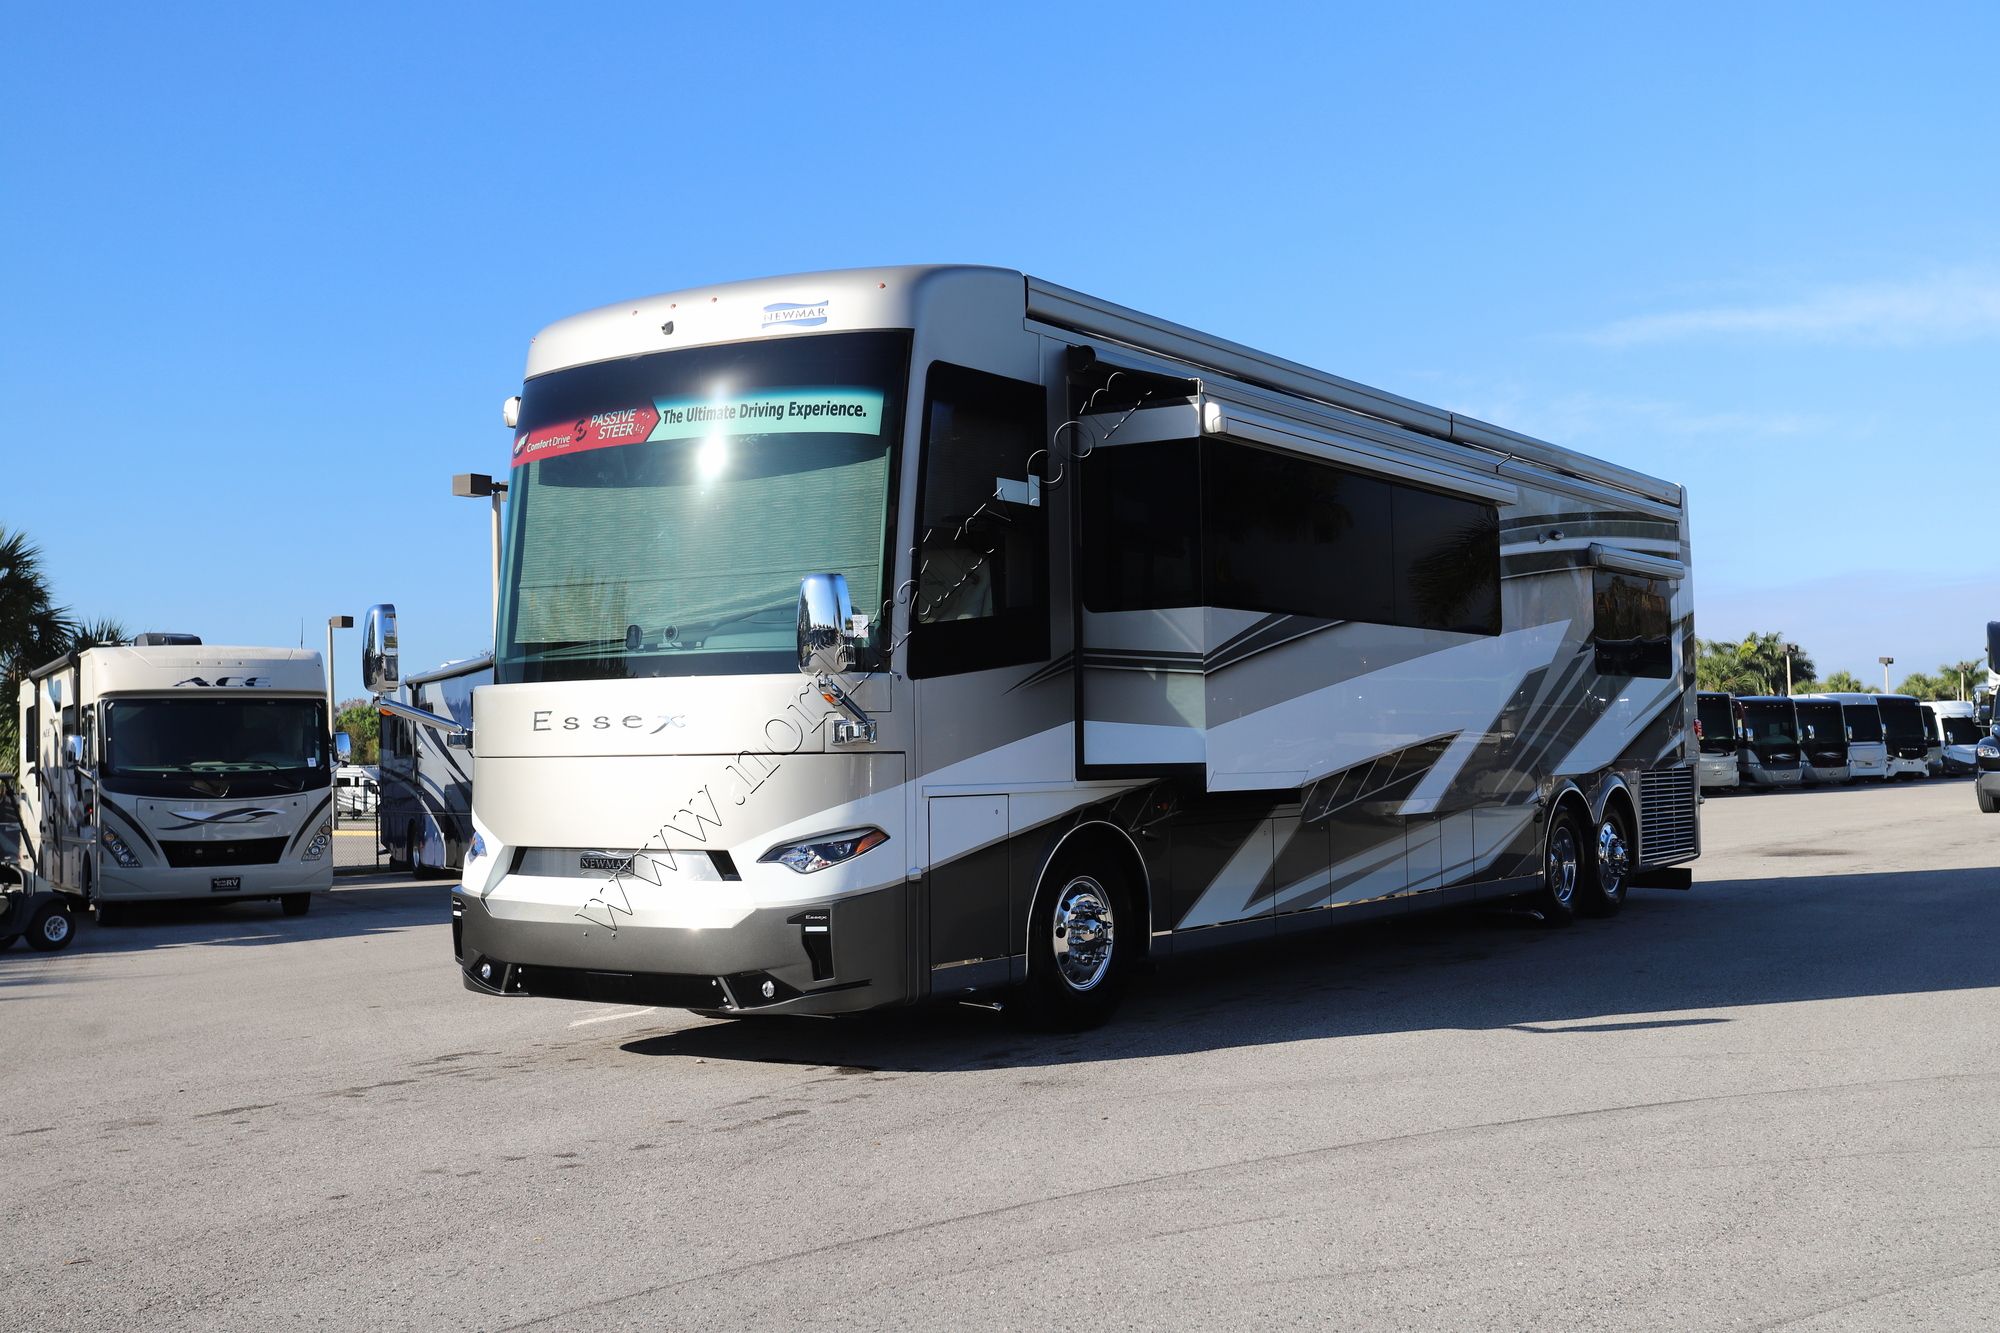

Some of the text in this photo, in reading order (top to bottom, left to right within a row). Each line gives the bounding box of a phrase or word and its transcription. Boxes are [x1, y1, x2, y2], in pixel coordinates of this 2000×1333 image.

[764, 307, 826, 321] NEWMAR
[590, 408, 637, 428] PASSIVE
[663, 400, 868, 425] The Ultimate Driving Experience.
[598, 423, 634, 440] STEER
[526, 436, 552, 453] Comfort
[533, 710, 686, 735] Essex
[581, 858, 631, 870] NEWMAR
